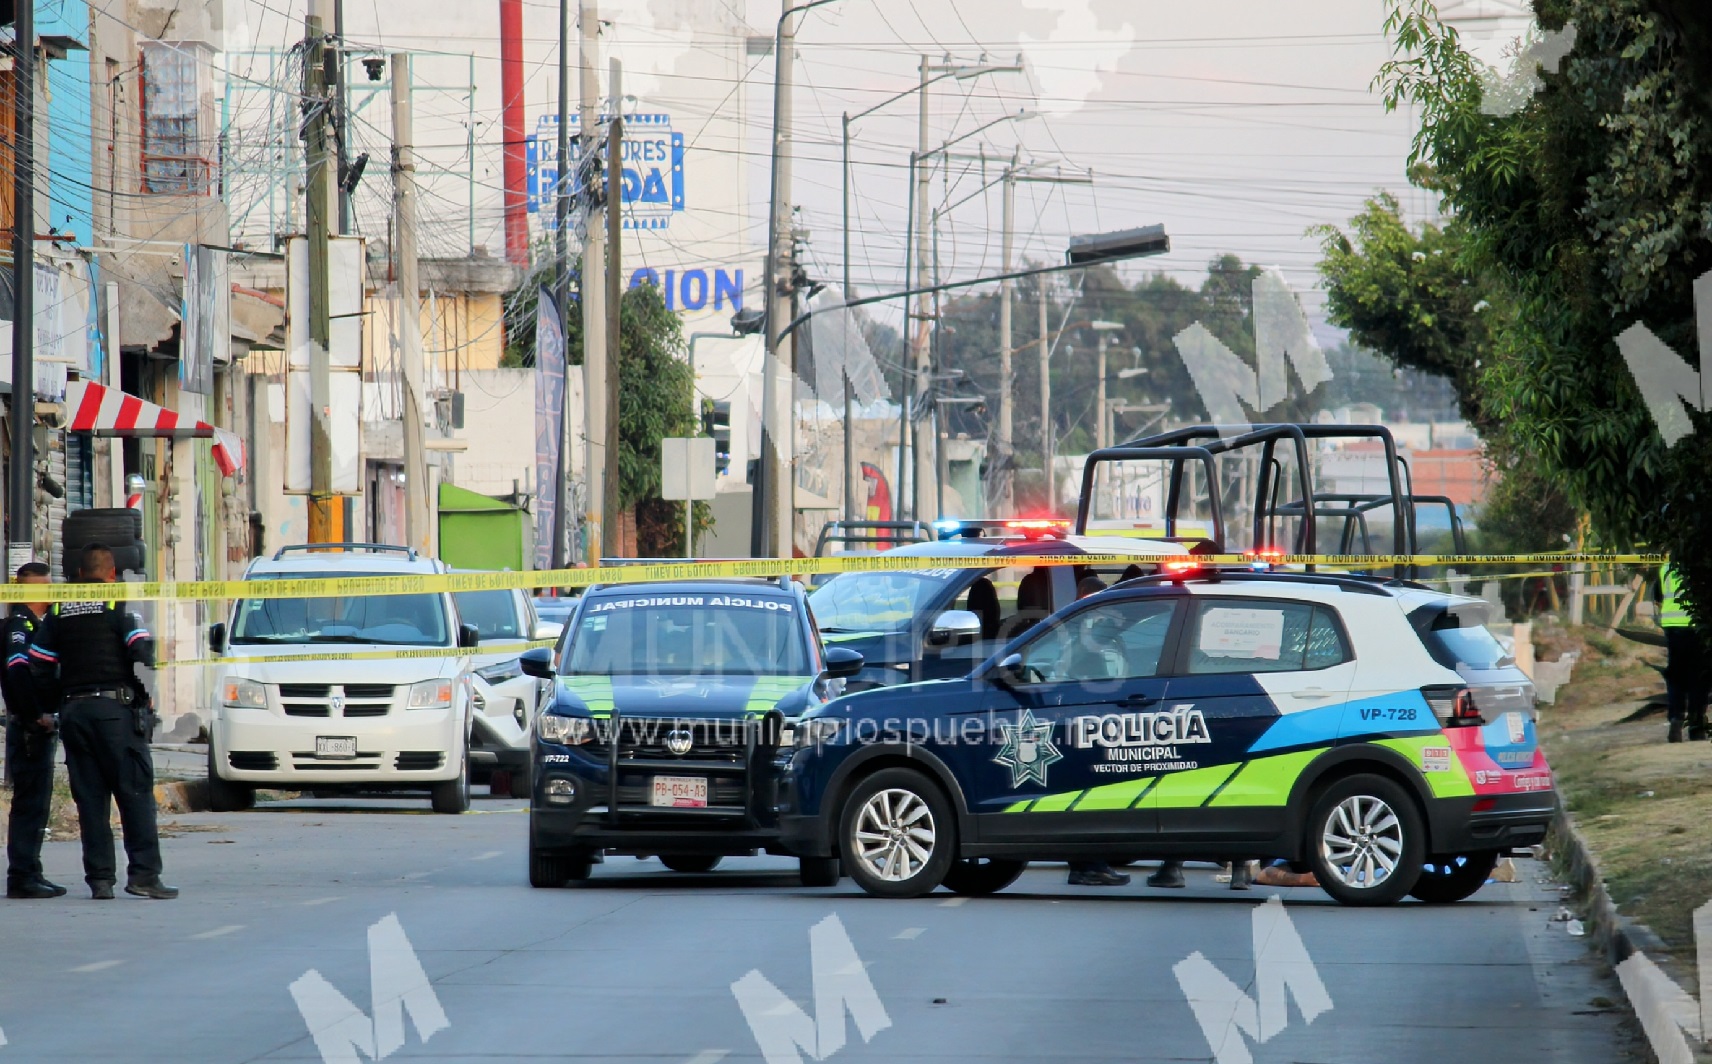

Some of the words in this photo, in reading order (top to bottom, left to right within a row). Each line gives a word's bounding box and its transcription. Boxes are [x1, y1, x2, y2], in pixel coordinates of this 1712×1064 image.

[1360, 708, 1417, 720] VP-728
[1073, 704, 1212, 749] POLICÍA
[545, 755, 569, 763] VP-722
[1108, 747, 1182, 761] MUNICIPAL
[1094, 764, 1128, 773] VECTOR
[1130, 763, 1142, 772] DE
[1144, 761, 1198, 771] PROXIMIDAD
[655, 782, 707, 797] PB-054-A3
